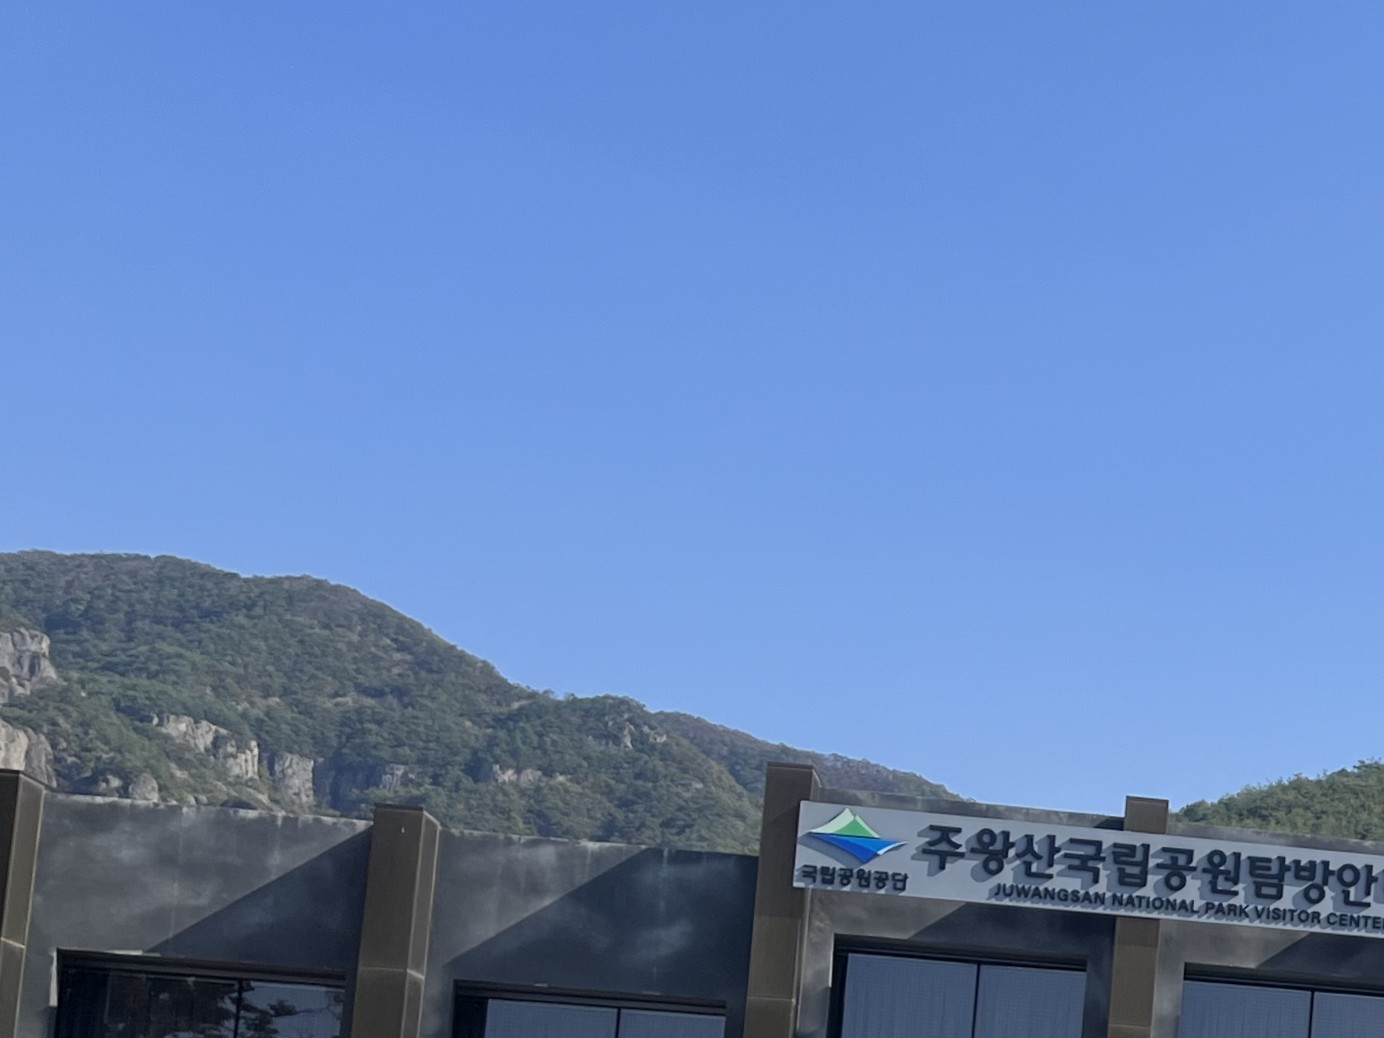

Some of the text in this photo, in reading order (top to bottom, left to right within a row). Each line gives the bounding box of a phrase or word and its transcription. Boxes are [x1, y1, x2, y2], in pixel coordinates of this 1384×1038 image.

[801, 863, 909, 892] 국립공원공단
[994, 883, 1106, 906] JUWANGSAN
[1111, 894, 1200, 914] NATIONAL
[1204, 902, 1250, 918] PARK
[1255, 906, 1321, 924] VISITOR
